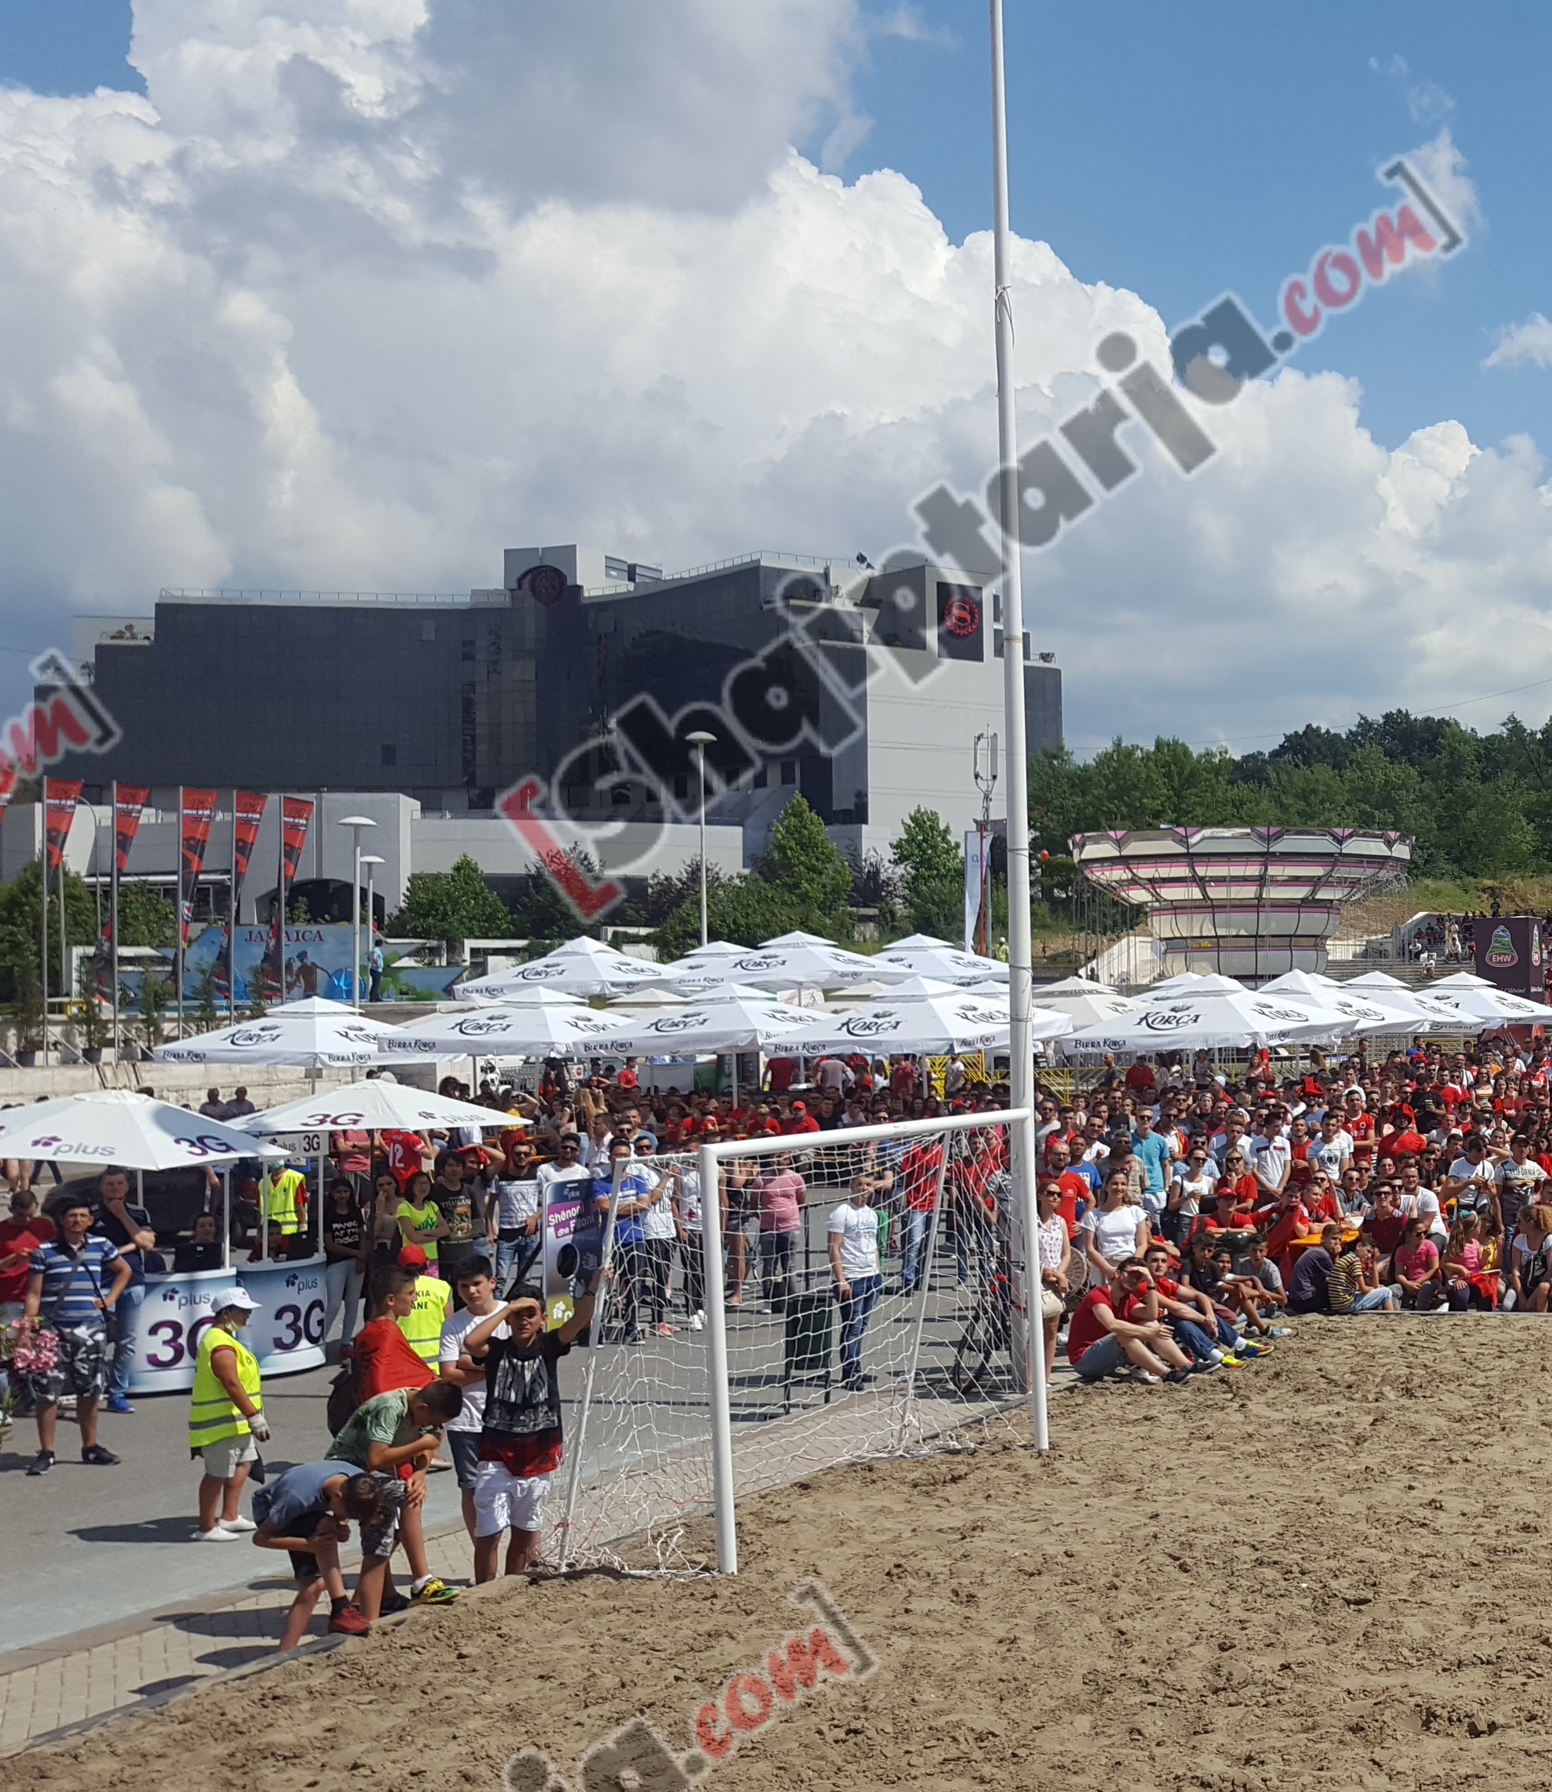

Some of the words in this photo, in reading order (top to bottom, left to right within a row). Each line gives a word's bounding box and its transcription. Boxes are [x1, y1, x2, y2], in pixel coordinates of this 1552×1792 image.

[245, 929, 324, 944] JAAICA
[1492, 954, 1512, 963] EHW
[301, 1112, 365, 1127] 3G
[441, 1111, 486, 1126] plus
[52, 1142, 116, 1158] plus
[174, 1134, 239, 1156] 3G
[303, 1134, 320, 1152] 3G
[389, 1142, 404, 1168] 12
[557, 1226, 569, 1237] dhe
[297, 1276, 318, 1294] plus
[178, 1291, 211, 1310] plus
[415, 1289, 431, 1298] KIA
[273, 1299, 325, 1351] 3G
